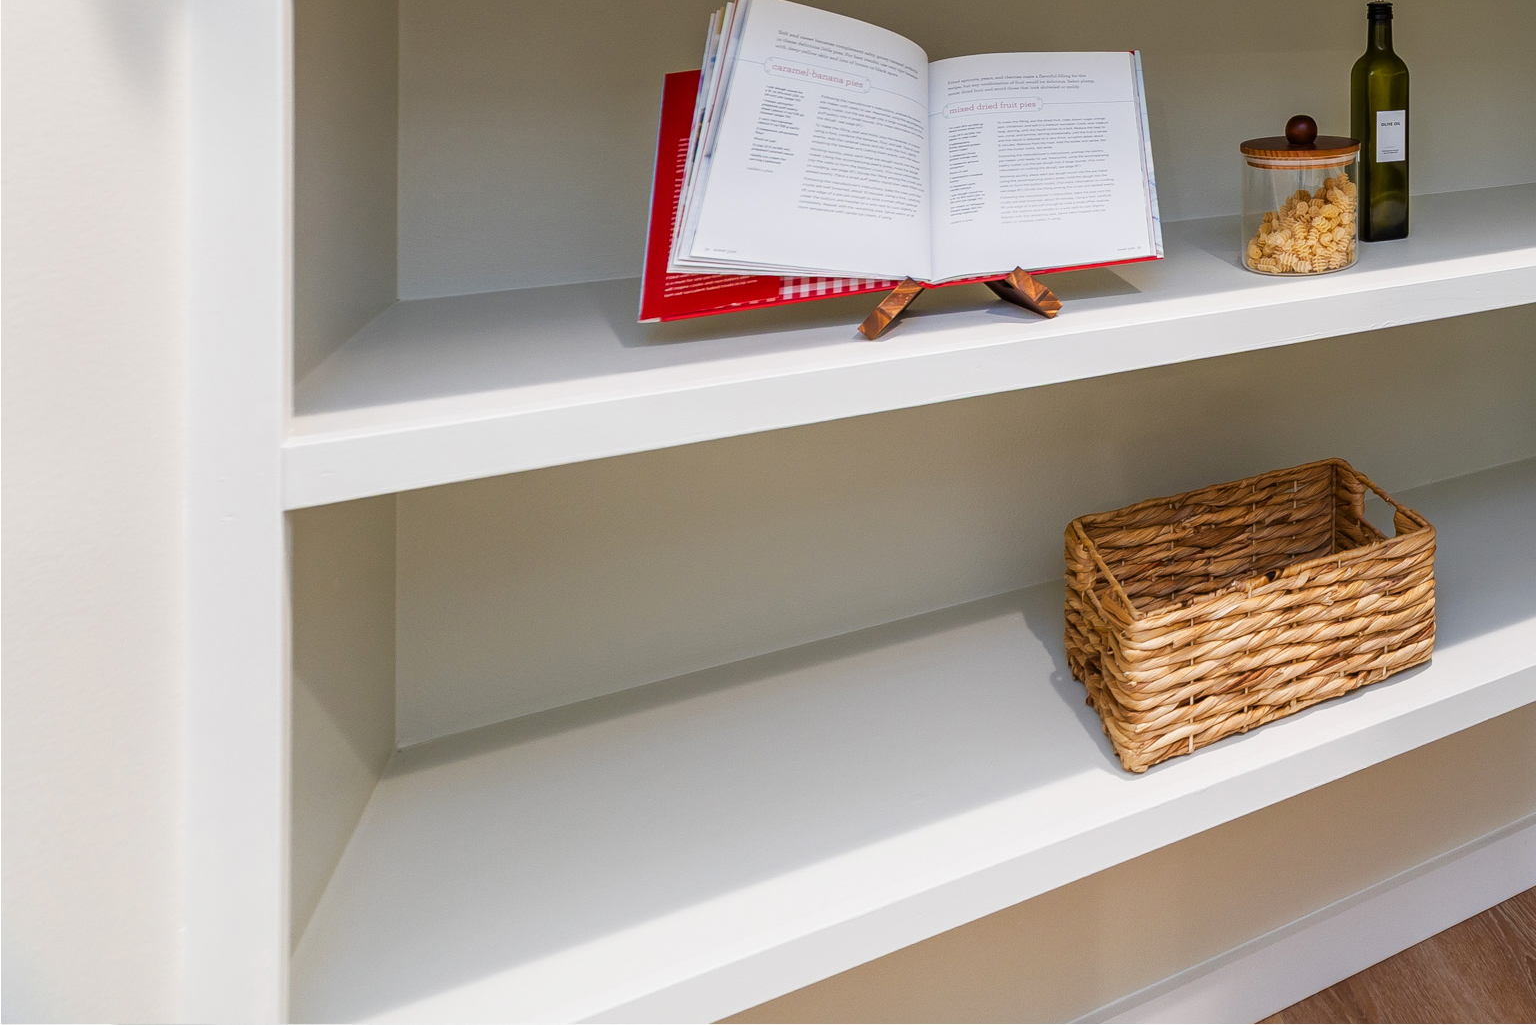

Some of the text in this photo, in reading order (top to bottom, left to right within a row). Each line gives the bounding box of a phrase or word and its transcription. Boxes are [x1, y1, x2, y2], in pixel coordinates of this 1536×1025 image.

[772, 64, 863, 88] caramel-banana pies
[949, 101, 1036, 114] mixed dried fruit pies
